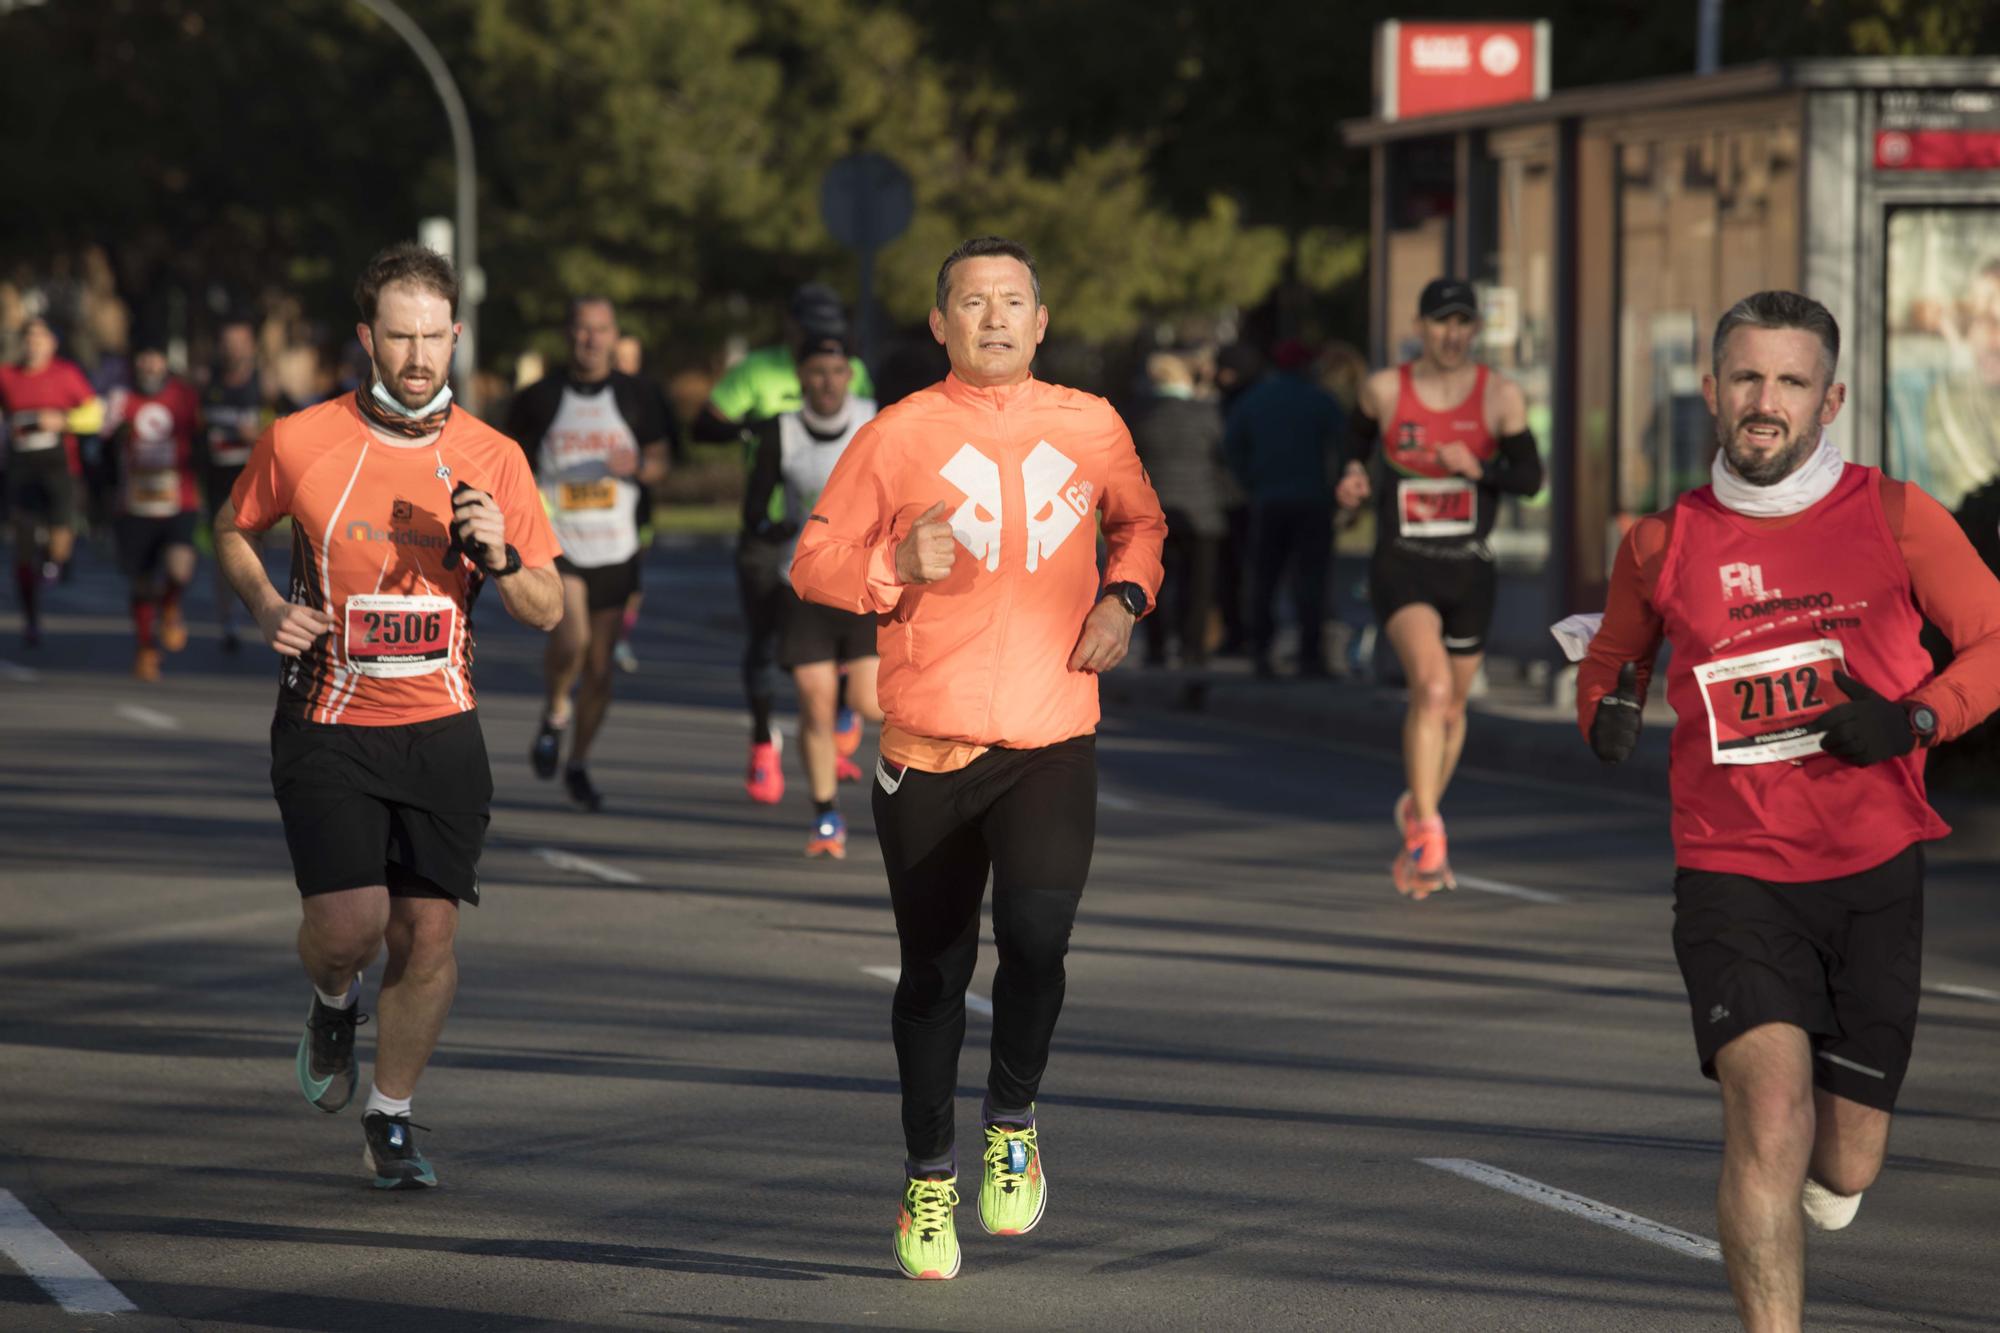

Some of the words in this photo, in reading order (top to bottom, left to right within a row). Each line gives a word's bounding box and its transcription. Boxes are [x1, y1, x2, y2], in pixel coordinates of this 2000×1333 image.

[1728, 592, 1834, 621] ROMPIENDO
[363, 612, 441, 644] 2506
[1733, 666, 1824, 722] 2712
